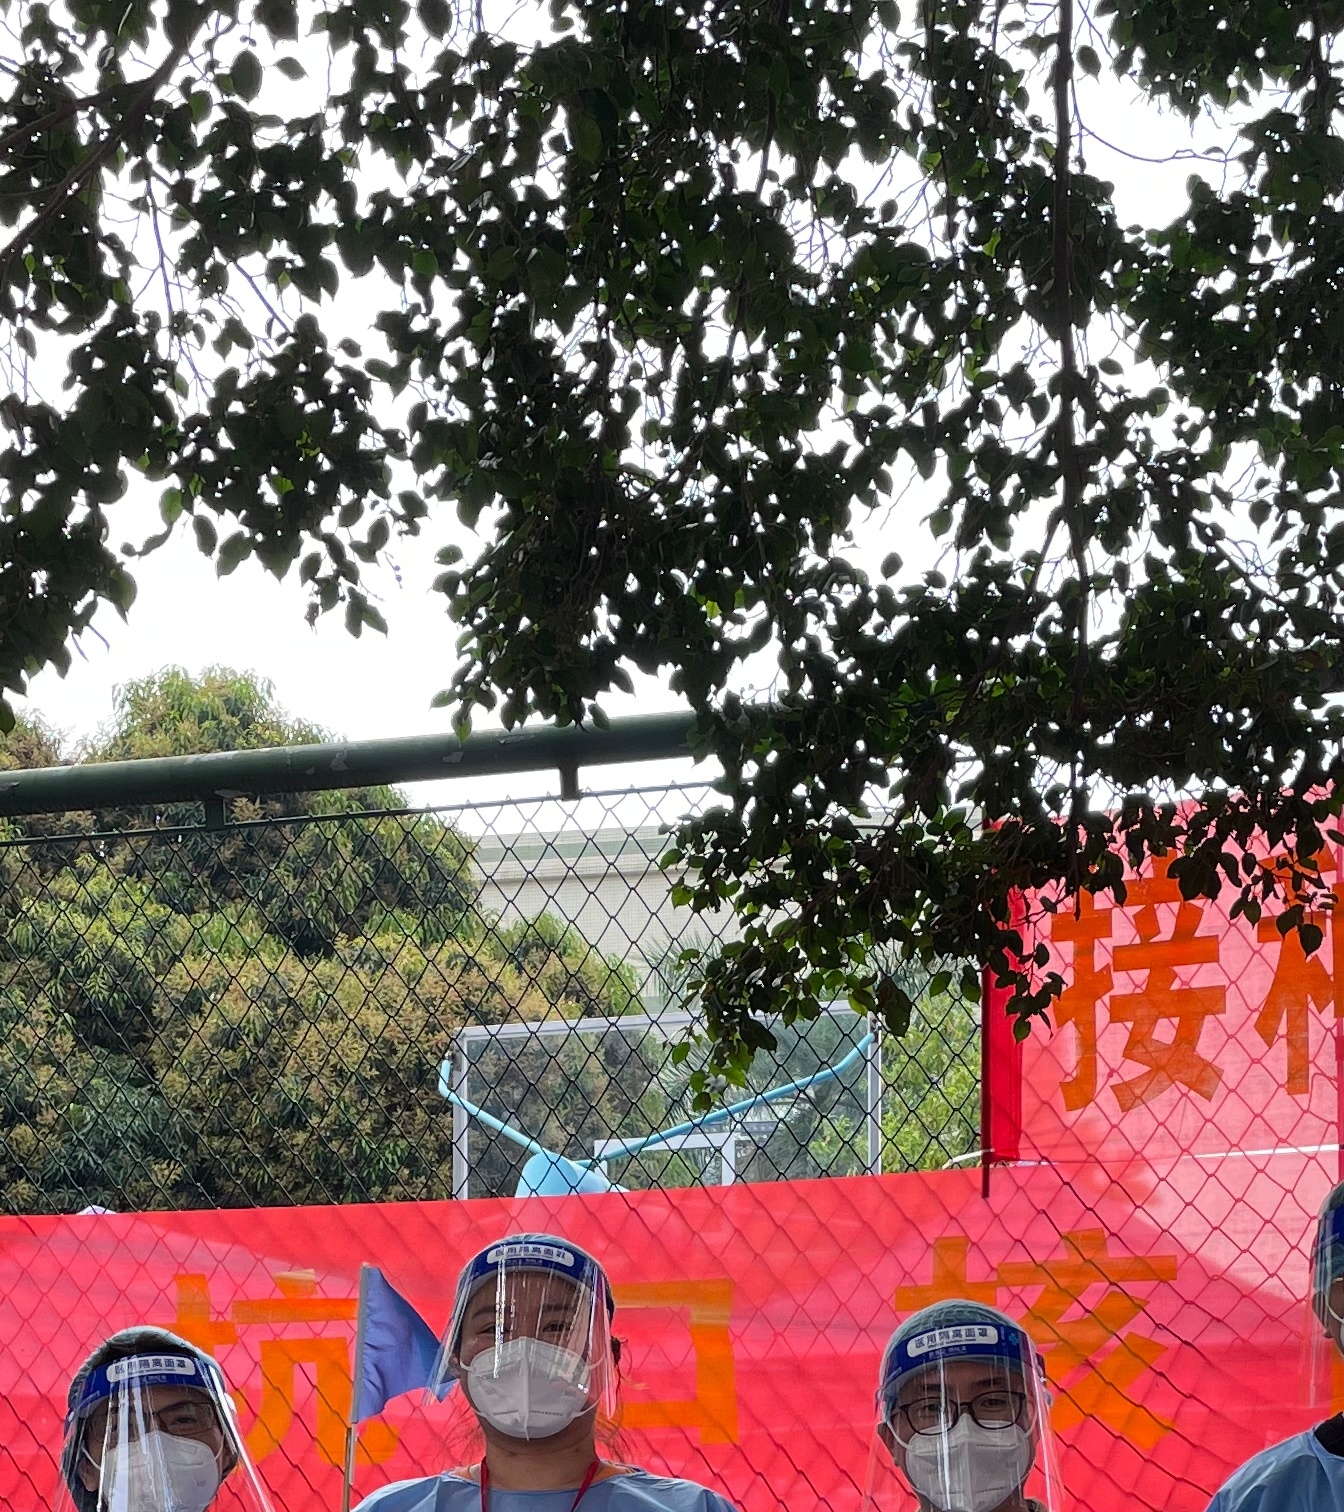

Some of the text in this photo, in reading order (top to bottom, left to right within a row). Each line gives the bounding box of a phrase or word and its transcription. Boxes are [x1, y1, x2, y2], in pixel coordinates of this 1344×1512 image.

[914, 1327, 989, 1349] 医用隔离面罩
